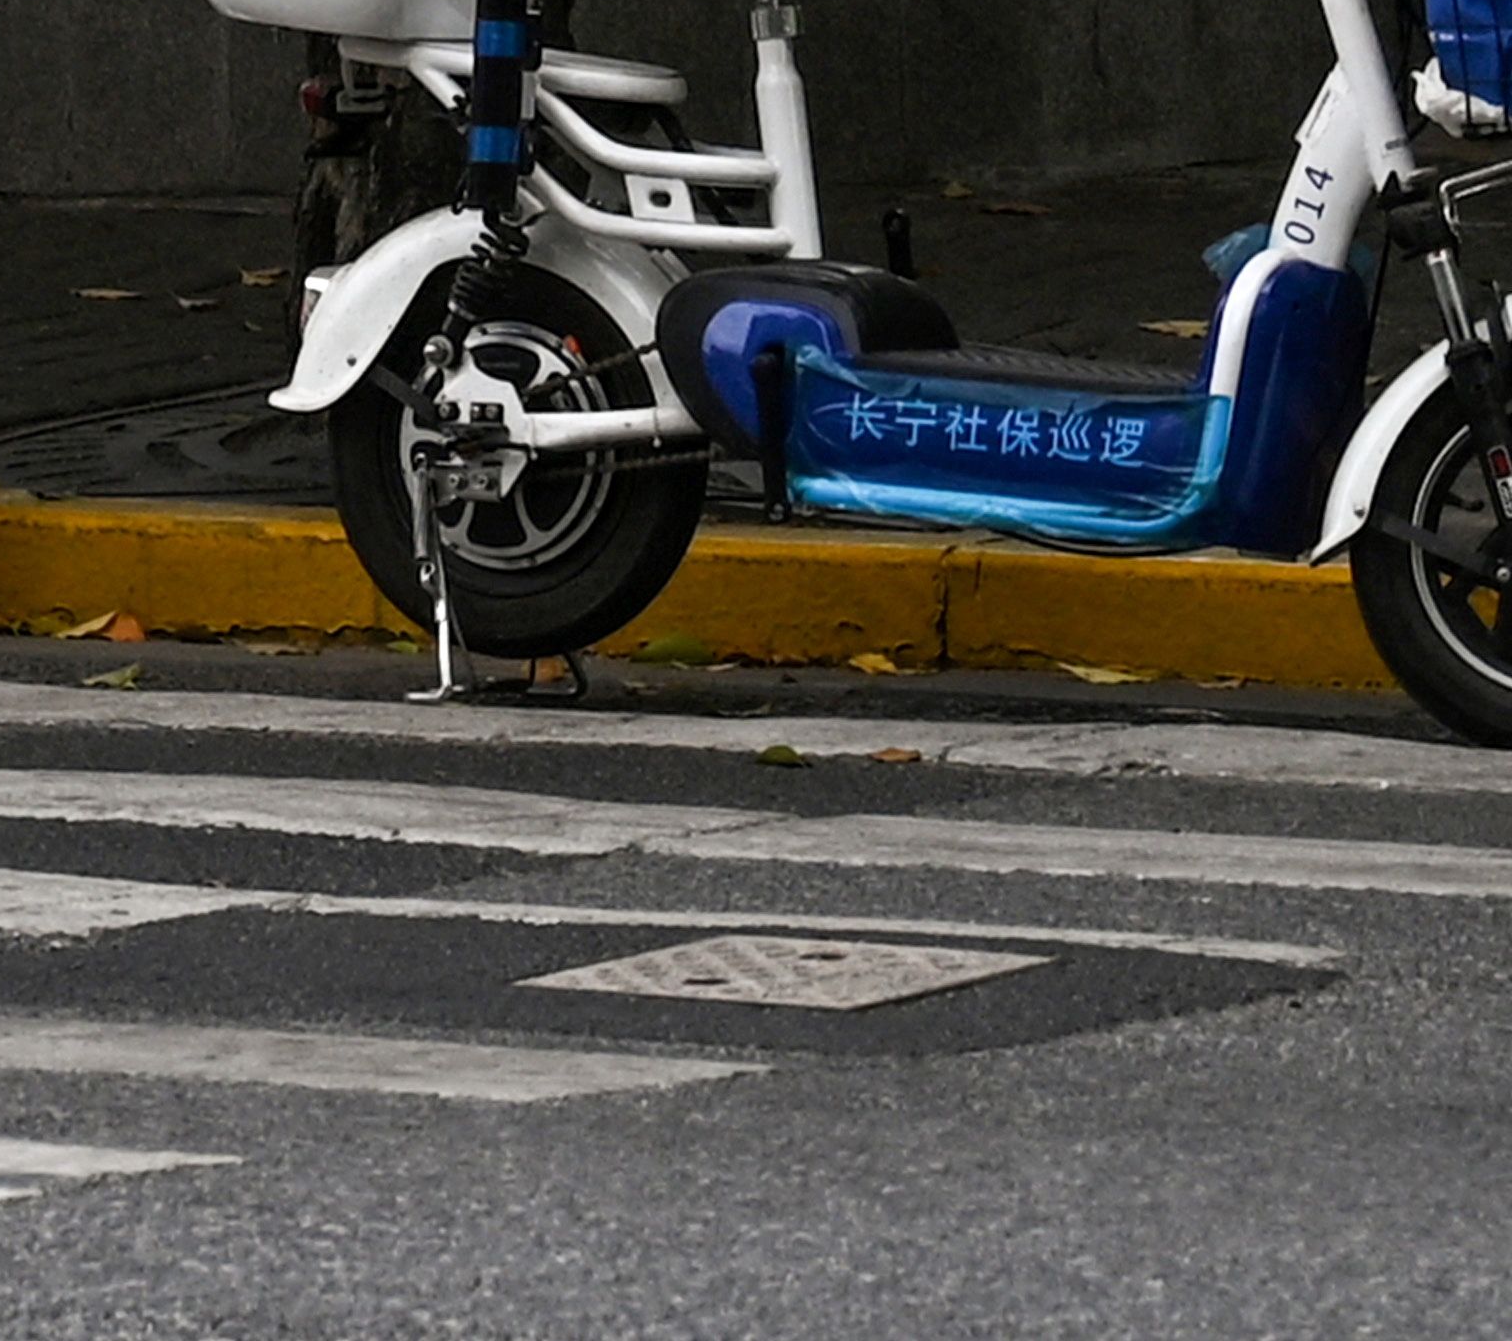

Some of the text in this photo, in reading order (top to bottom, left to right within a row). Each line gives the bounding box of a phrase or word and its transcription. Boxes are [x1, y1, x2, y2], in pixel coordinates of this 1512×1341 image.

[1284, 165, 1334, 245] 014
[843, 391, 1148, 468] 长宁社保巡逻
